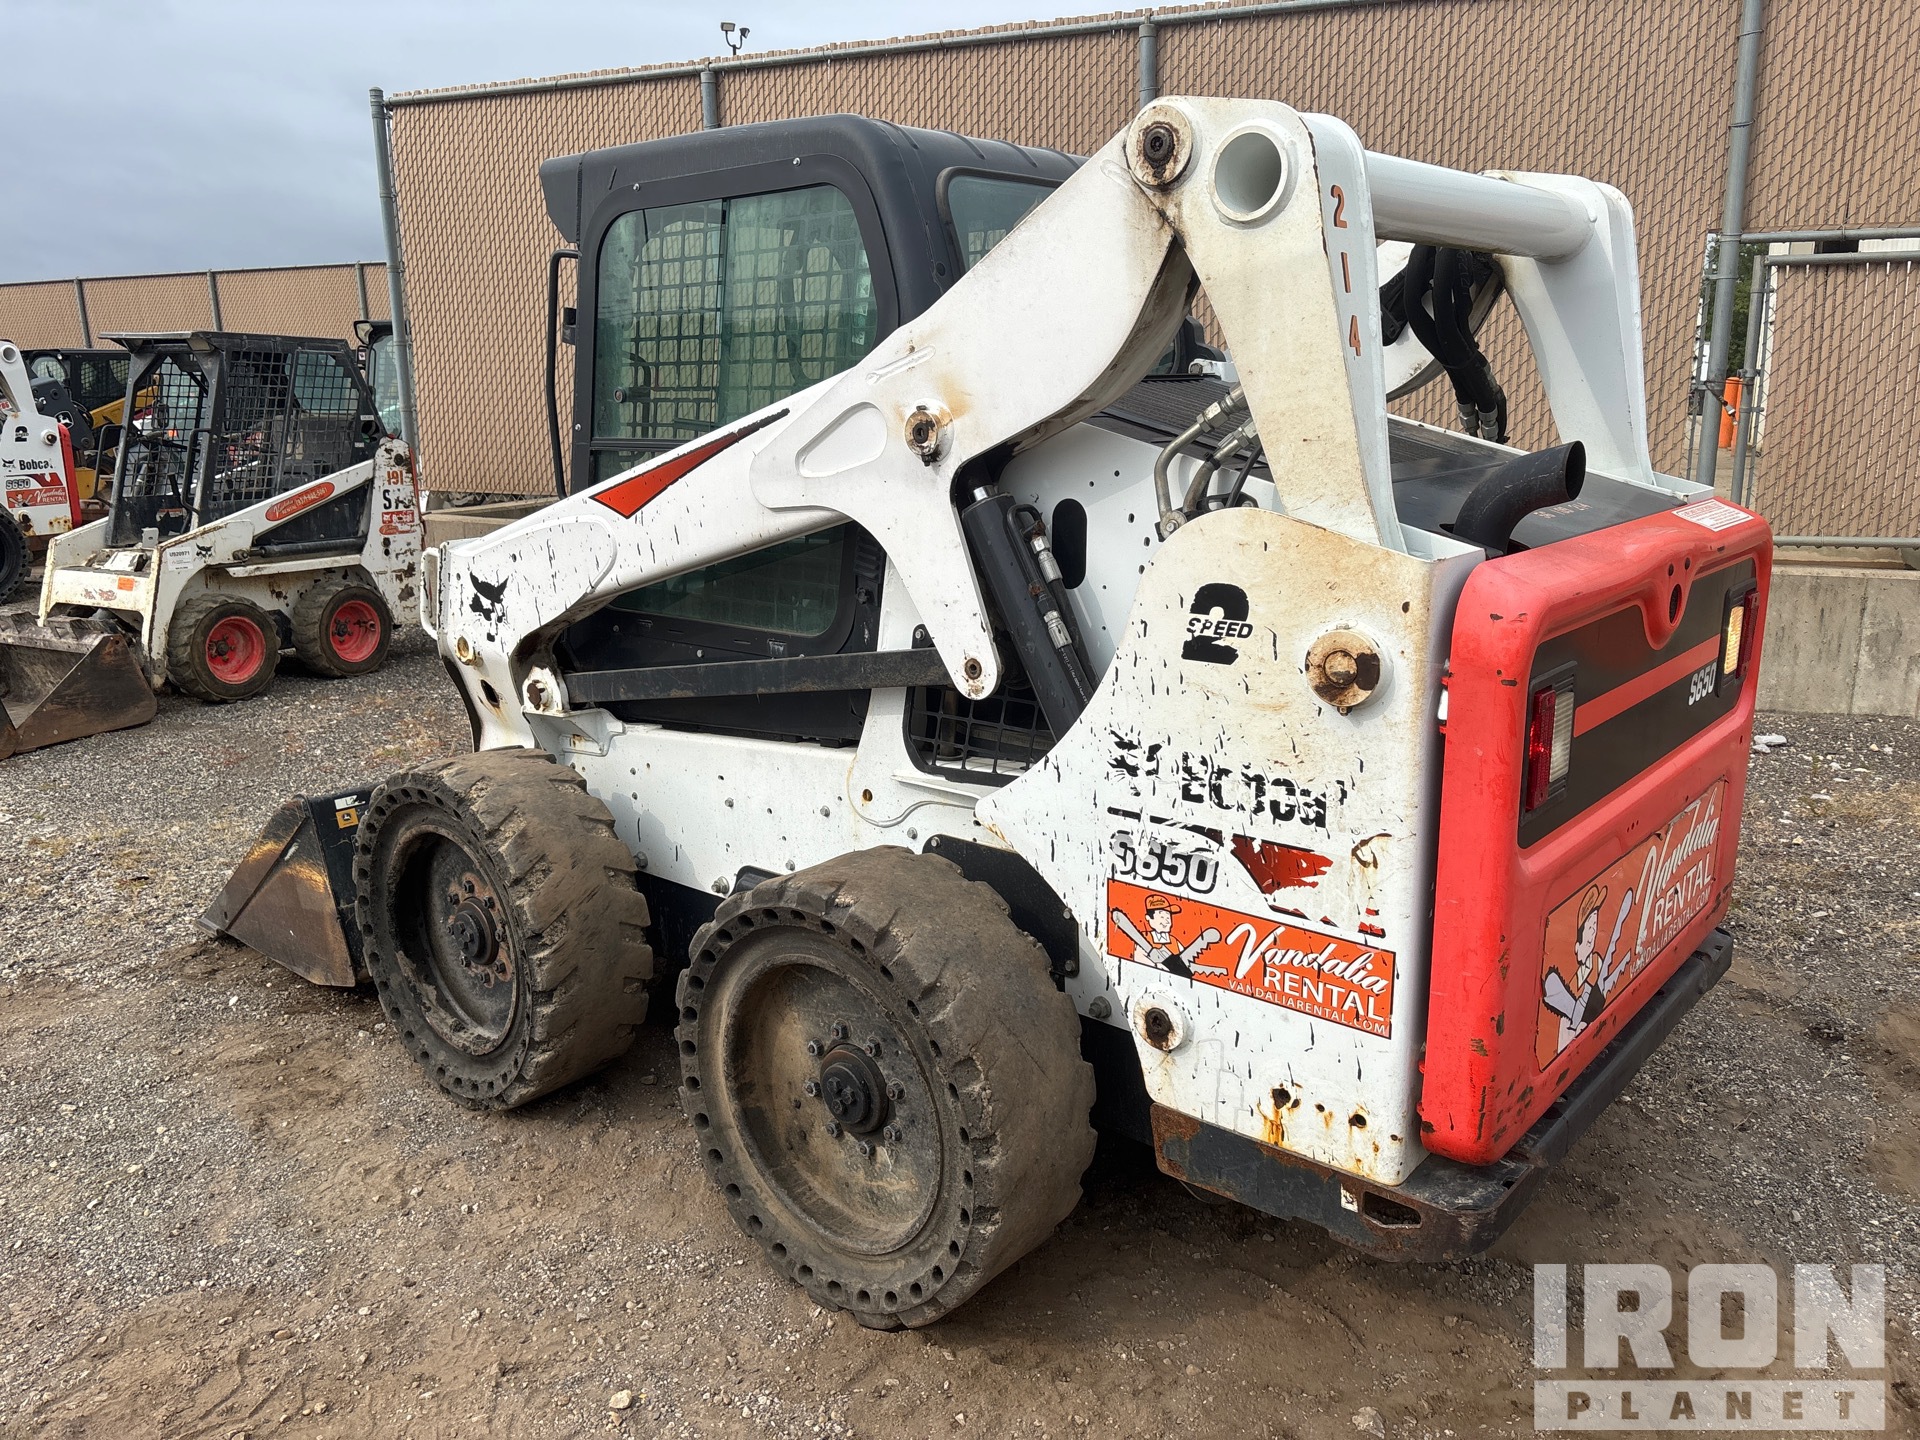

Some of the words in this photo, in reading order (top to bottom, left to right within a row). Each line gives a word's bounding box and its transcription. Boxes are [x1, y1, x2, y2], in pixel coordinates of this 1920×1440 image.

[1330, 184, 1361, 357] 214
[6, 478, 31, 490] S650
[42, 495, 66, 503] RENTAL
[1181, 582, 1250, 665] 2
[1185, 617, 1254, 640] SPEED
[1688, 662, 1717, 706] S650
[1110, 829, 1220, 894] S650
[1652, 852, 1713, 936] RENTAL
[1225, 922, 1391, 995] Vandalia
[1227, 979, 1388, 1035] VANDALIARENTAL.COM
[1262, 965, 1385, 1022] RENTAL
